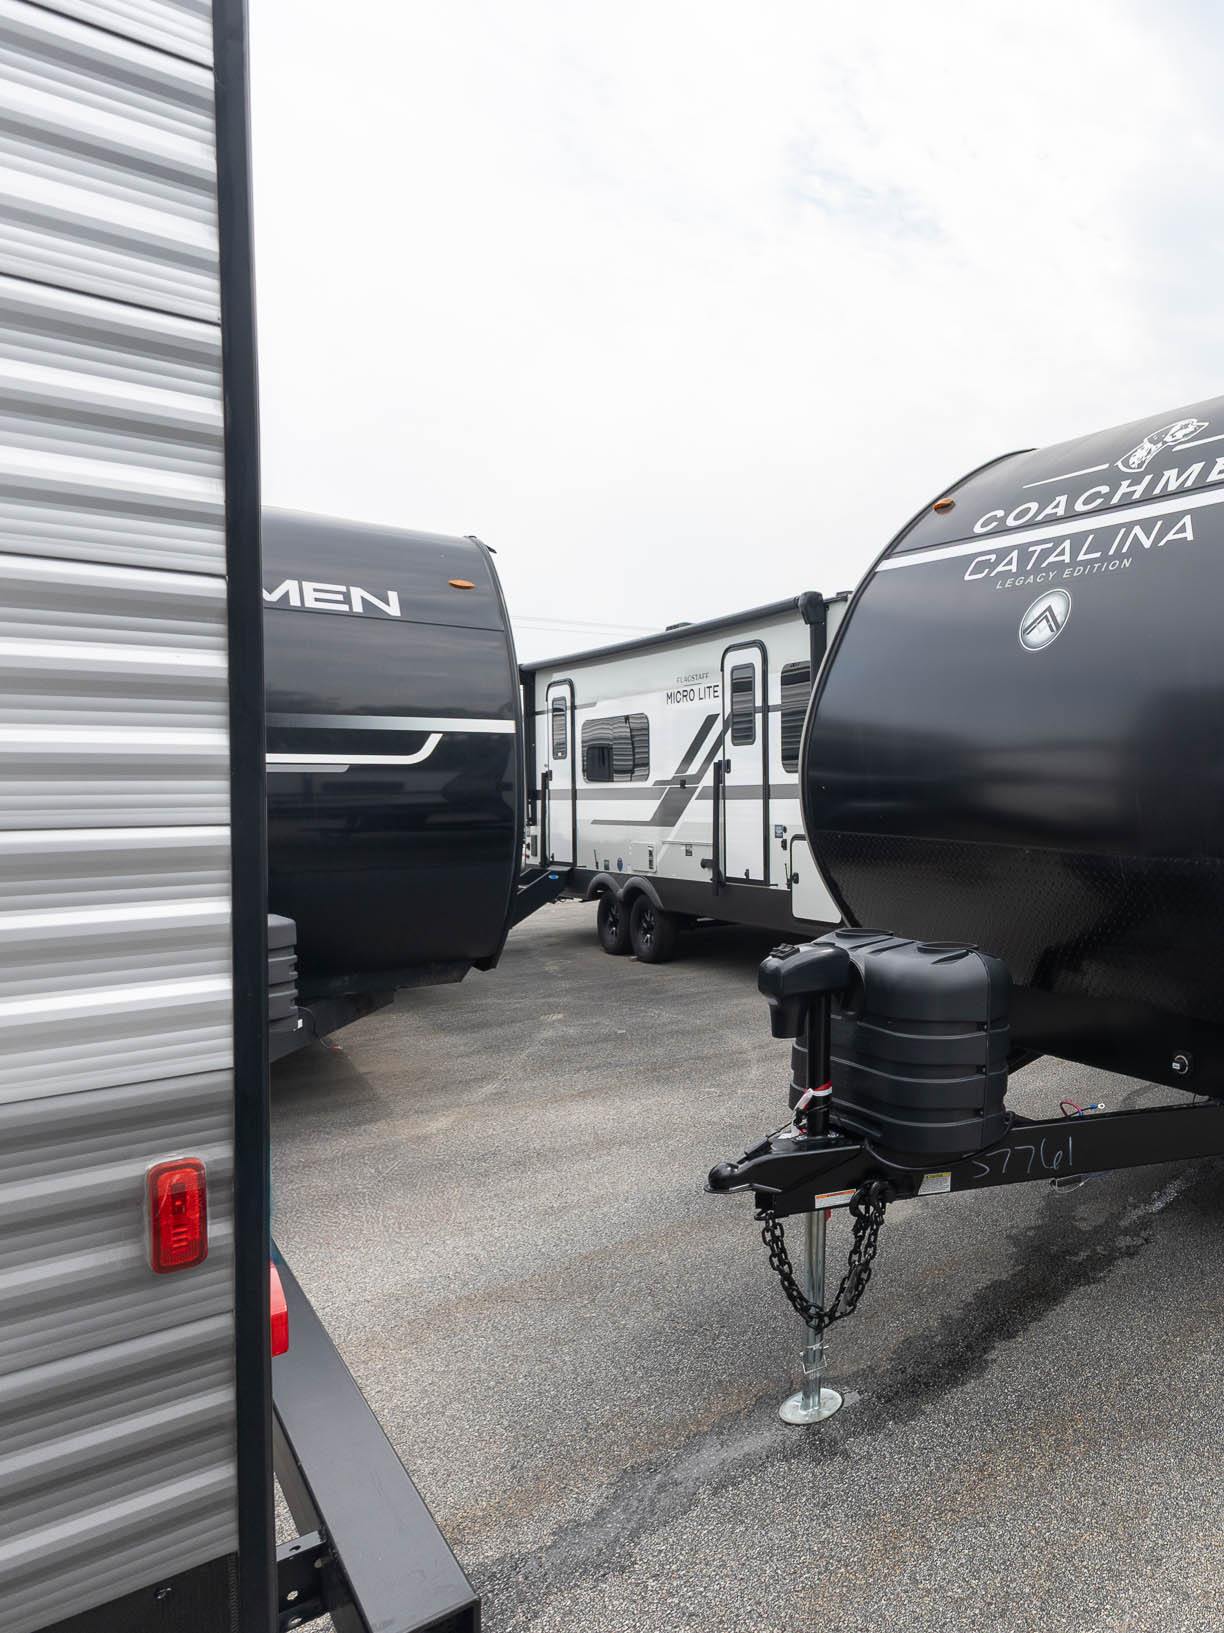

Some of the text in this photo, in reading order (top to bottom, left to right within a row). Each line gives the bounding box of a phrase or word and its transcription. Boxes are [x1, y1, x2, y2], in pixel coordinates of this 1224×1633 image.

[963, 514, 1195, 581] CATALINA
[996, 557, 1134, 590] LEGACY EDITION
[666, 684, 720, 705] MICRO LITE
